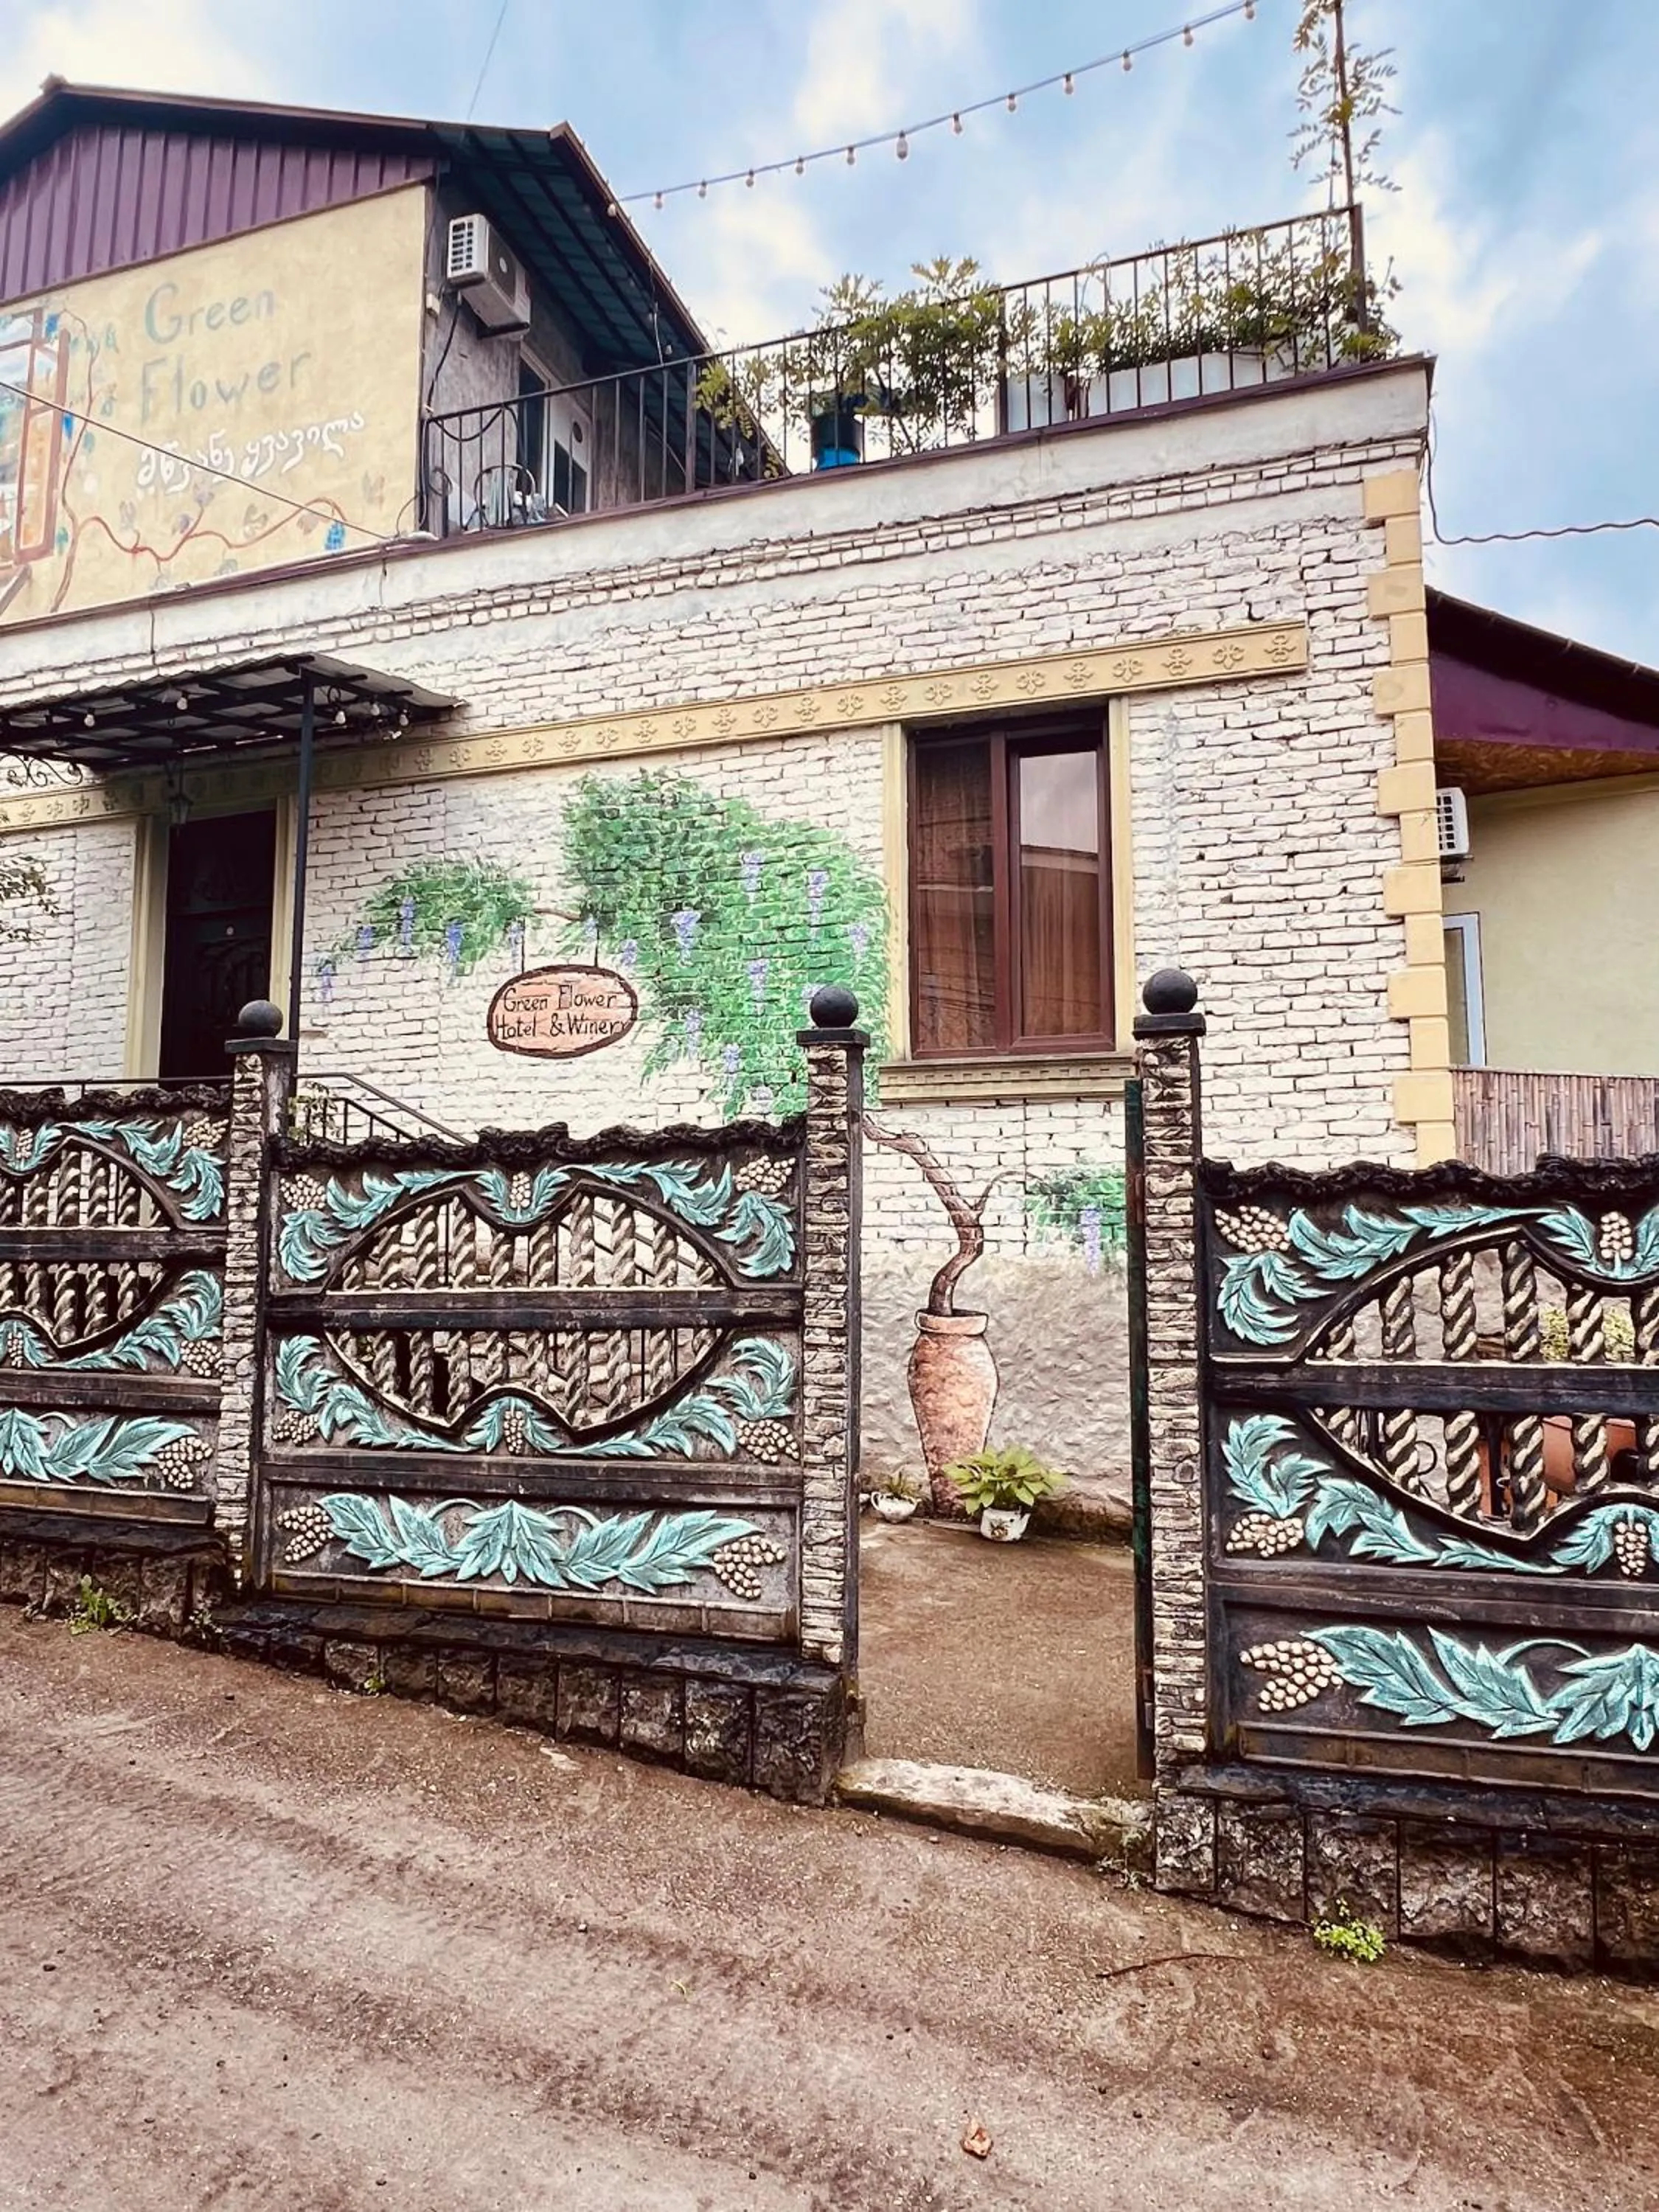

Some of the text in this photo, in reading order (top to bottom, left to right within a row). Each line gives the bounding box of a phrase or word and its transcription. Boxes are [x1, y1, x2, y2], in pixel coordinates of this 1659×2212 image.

[145, 282, 275, 344] Green
[141, 351, 311, 428] Flower
[504, 984, 616, 1012] Green Flower
[495, 1014, 536, 1040] Hotel
